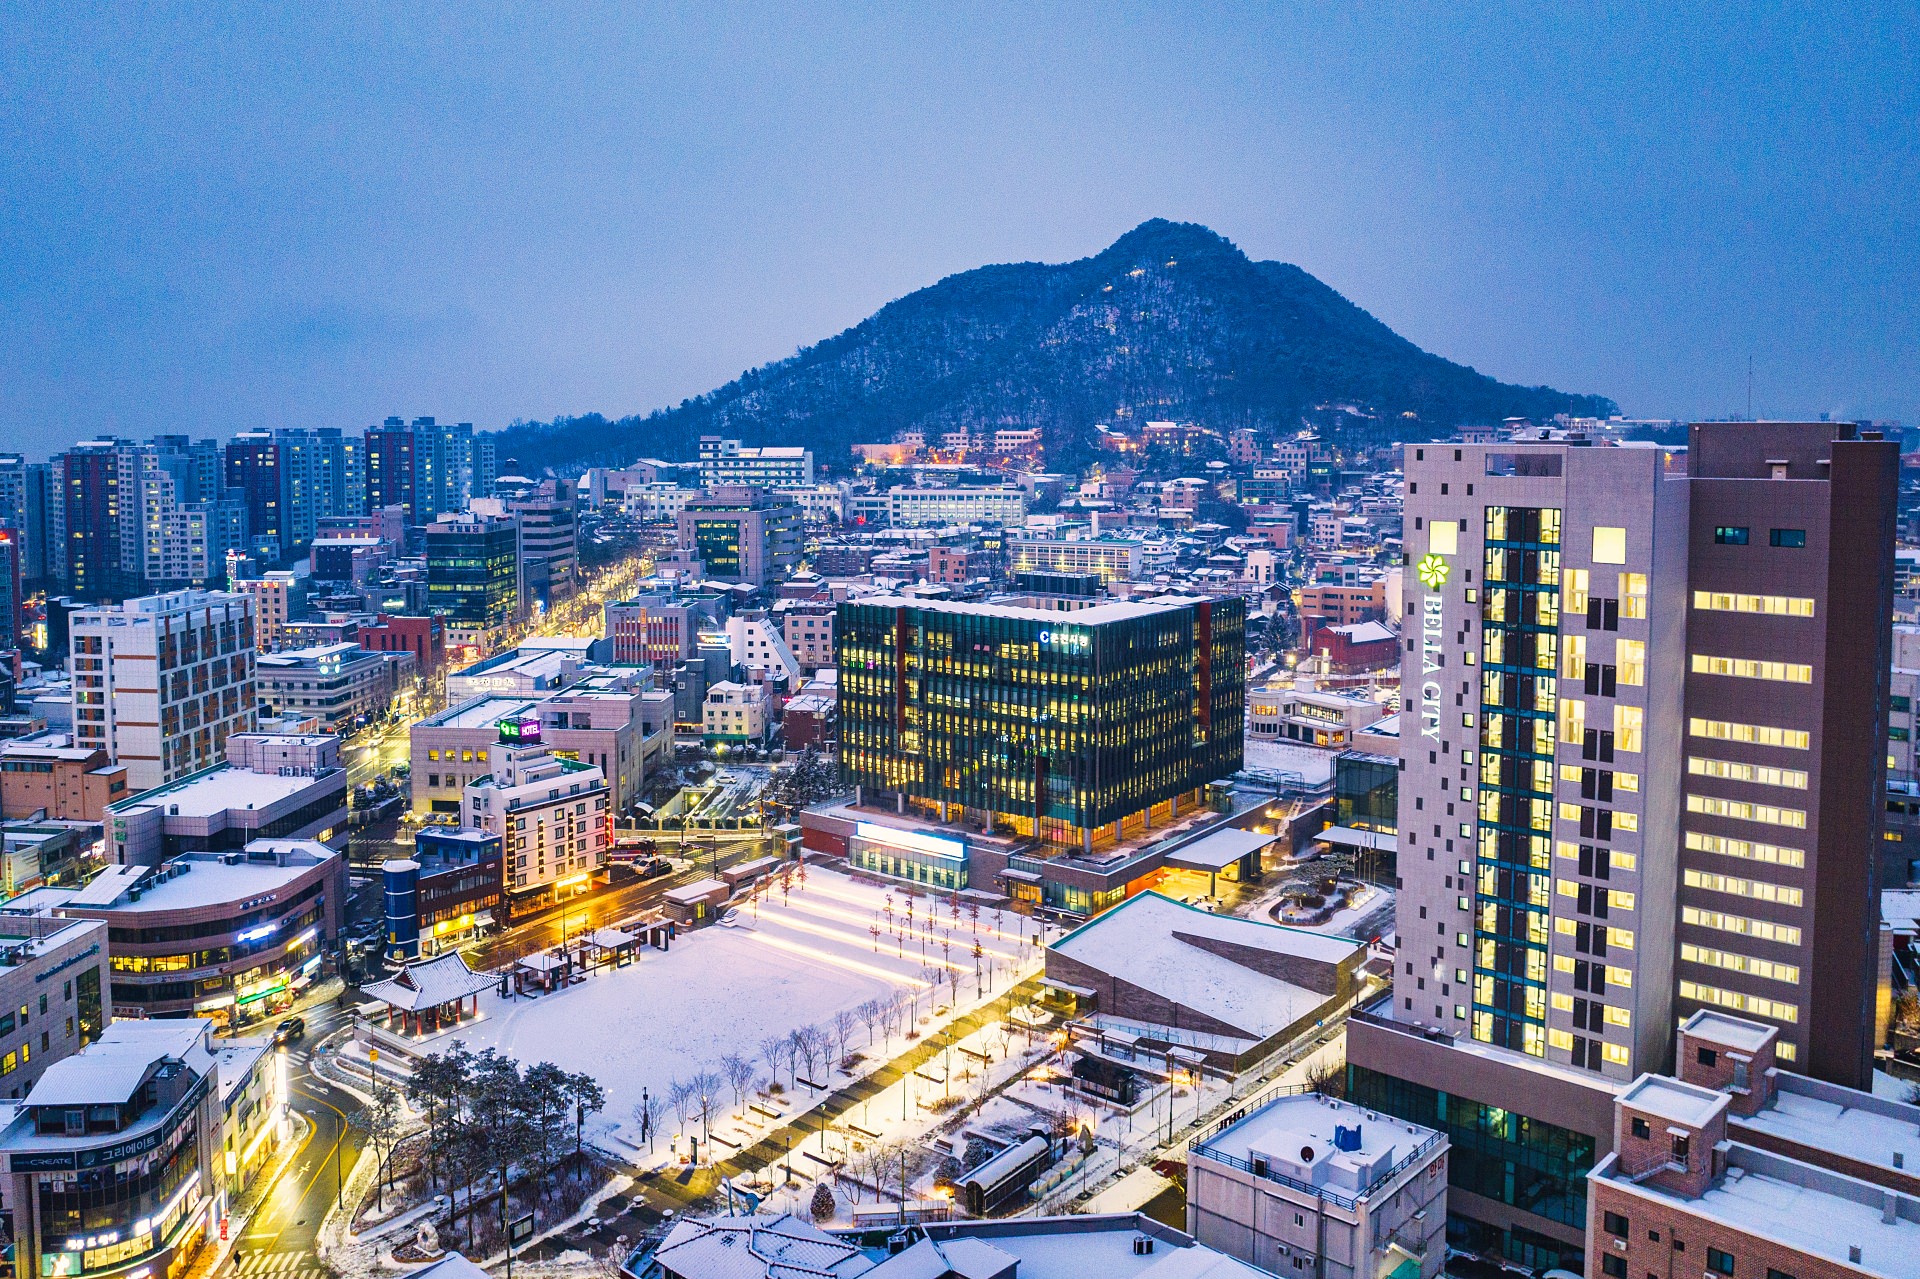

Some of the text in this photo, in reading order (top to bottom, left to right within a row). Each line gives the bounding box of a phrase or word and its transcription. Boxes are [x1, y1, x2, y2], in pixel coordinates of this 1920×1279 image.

[1050, 632, 1089, 647] 춘천시청
[1421, 594, 1443, 744] BELLA CITY
[521, 724, 541, 737] HOTEL
[30, 1157, 73, 1166] CREATE
